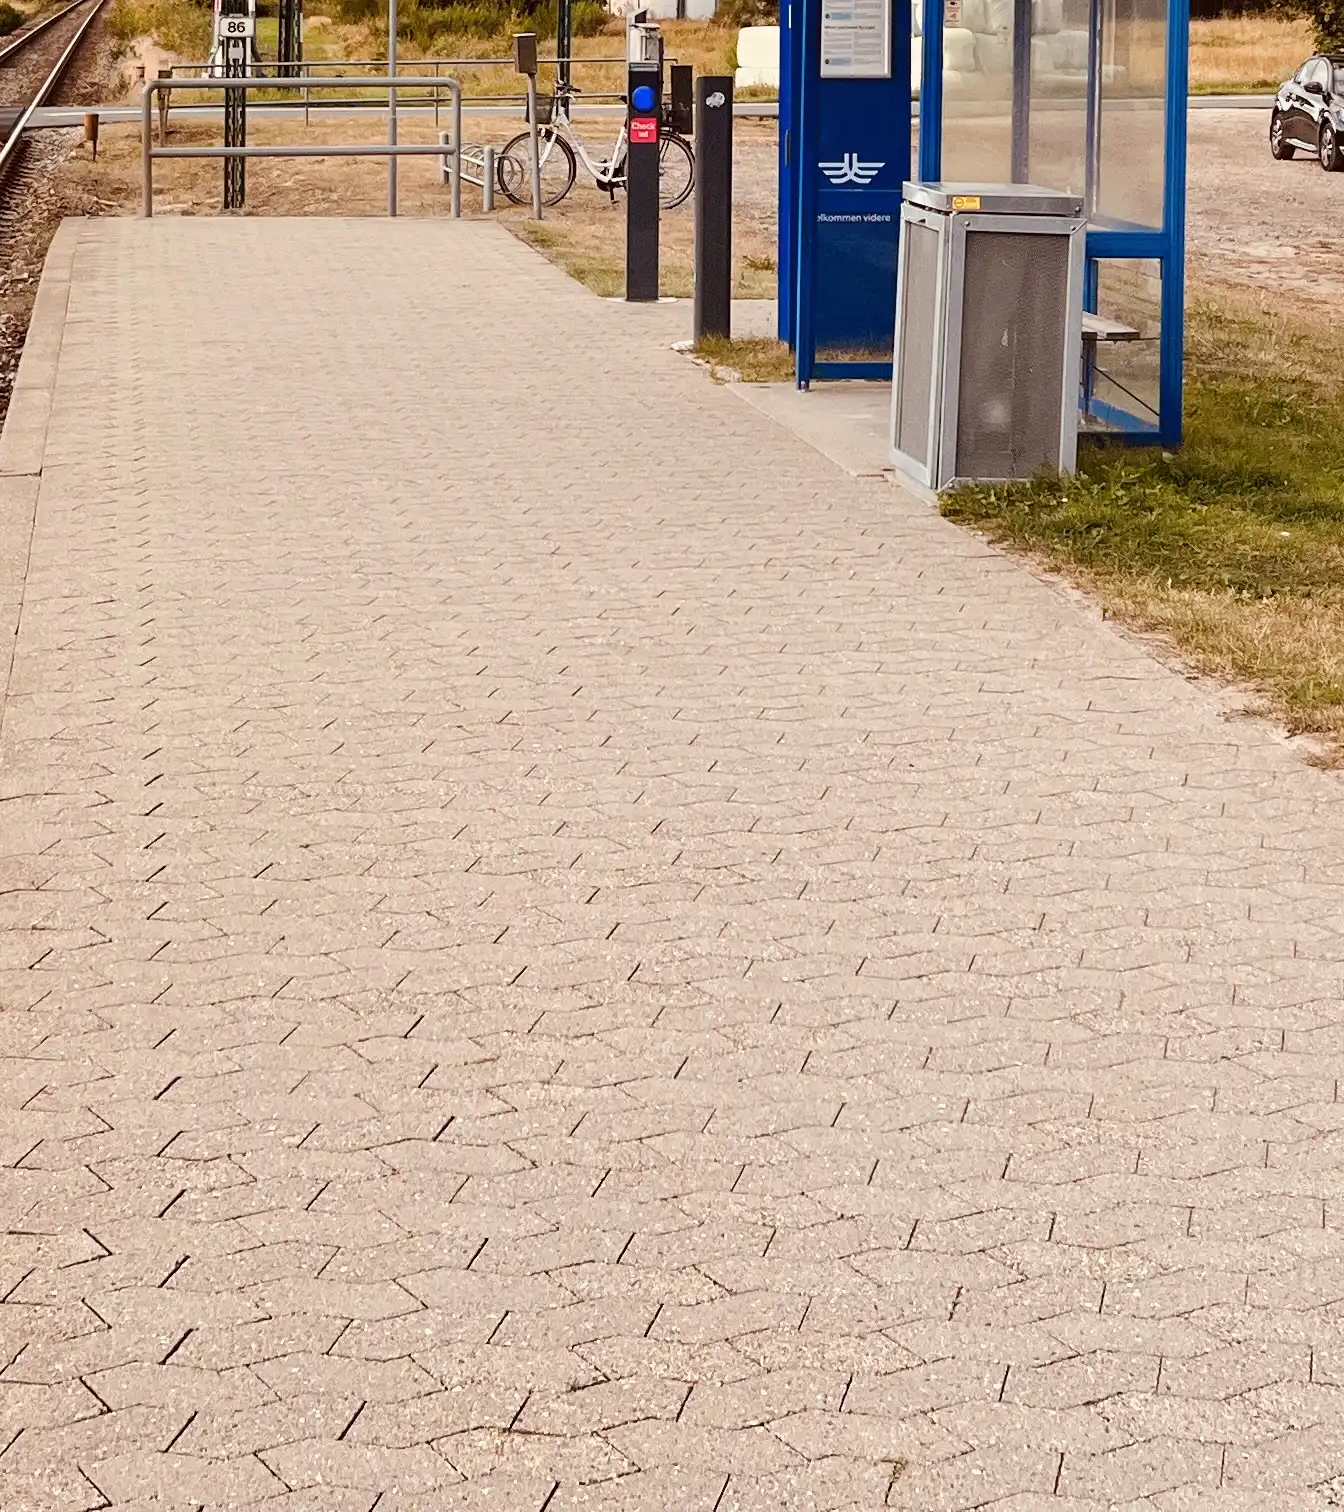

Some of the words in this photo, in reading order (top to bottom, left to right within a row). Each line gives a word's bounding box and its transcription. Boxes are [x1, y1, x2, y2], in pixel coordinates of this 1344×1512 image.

[227, 21, 246, 33] 86
[631, 121, 656, 130] Check
[816, 213, 862, 222] elkommen
[863, 213, 891, 222] videre
